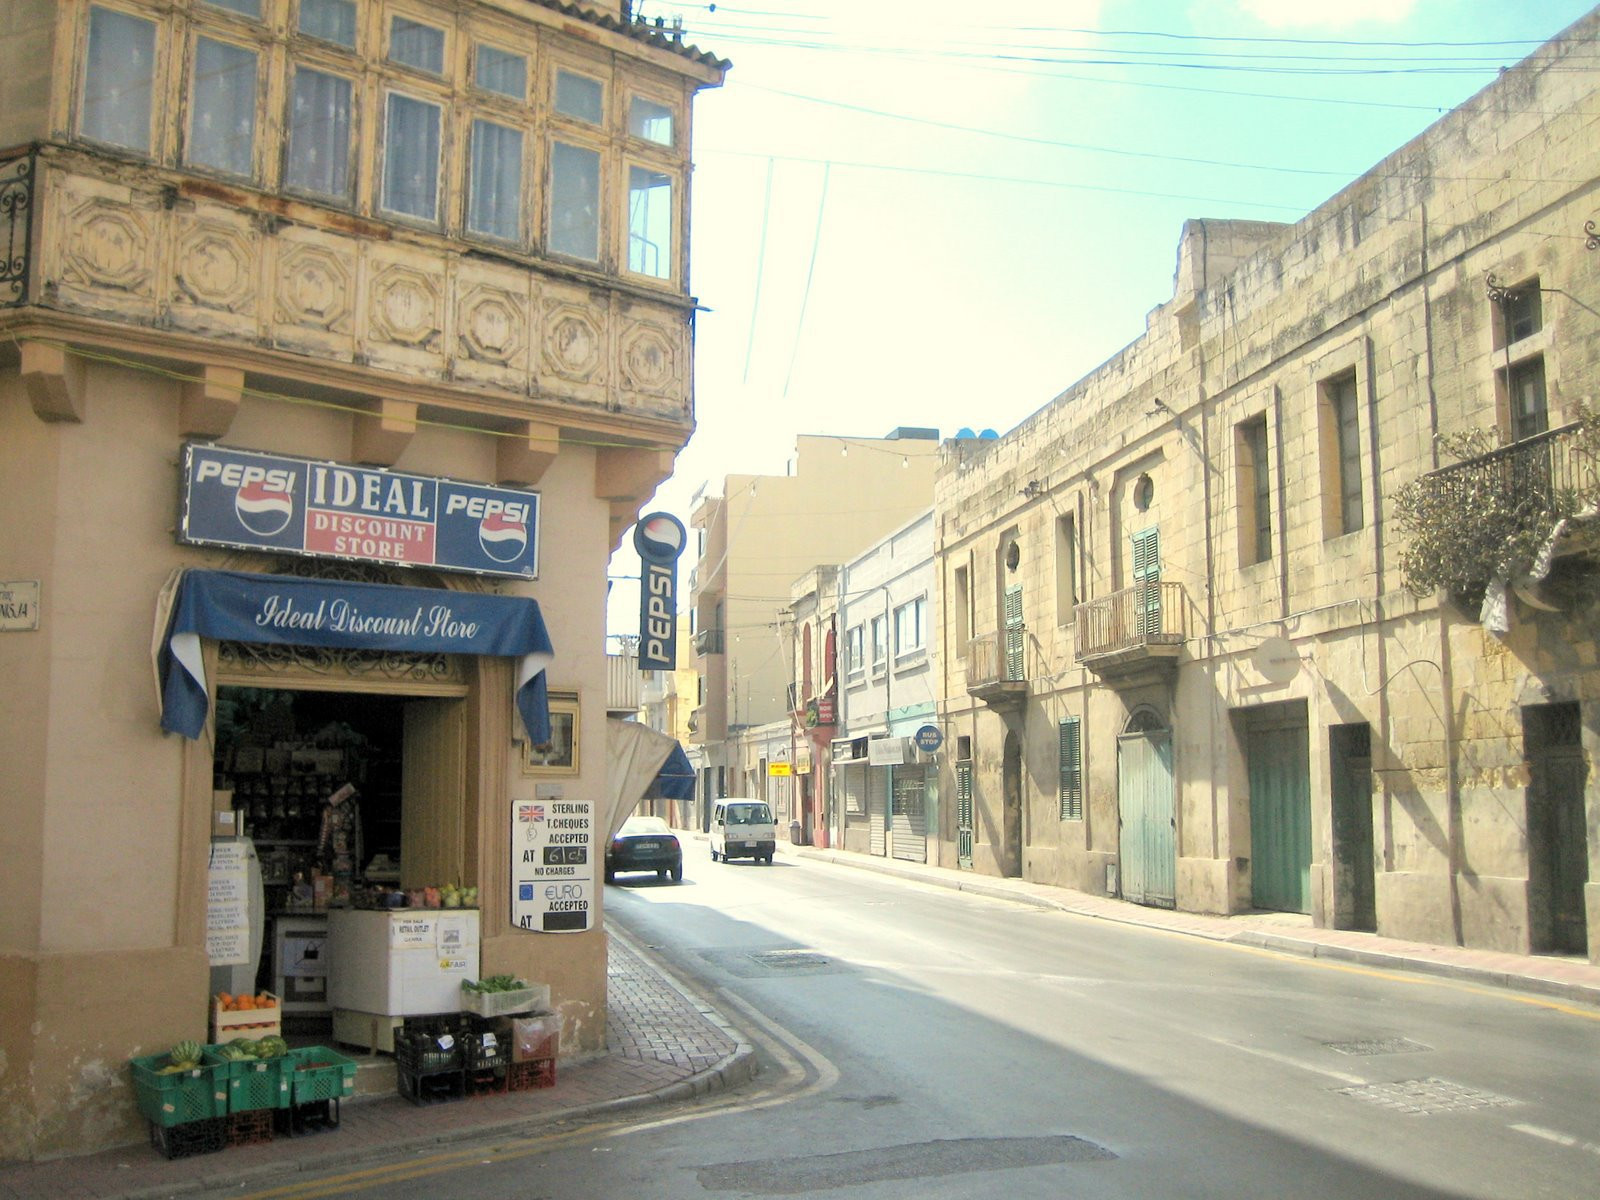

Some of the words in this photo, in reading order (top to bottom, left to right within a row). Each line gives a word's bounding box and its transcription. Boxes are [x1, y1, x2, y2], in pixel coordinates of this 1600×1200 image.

[196, 460, 296, 493] PEPSI
[314, 467, 429, 518] IDEAL
[445, 494, 531, 524] PEPSI
[314, 513, 427, 542] DISCOUNT
[335, 536, 405, 558] STORE
[256, 595, 326, 630] Ideal
[330, 599, 422, 636] Discount
[424, 605, 480, 639] Store
[647, 565, 672, 663] PEPSI
[552, 803, 589, 814] STERLING
[549, 834, 589, 844] ACCEPTED
[523, 850, 535, 862] AT
[535, 868, 544, 876] NO
[546, 867, 575, 876] CHARGES
[549, 901, 588, 911] ACCEPTED
[414, 925, 430, 933] OUTLET
[520, 915, 532, 928] AT
